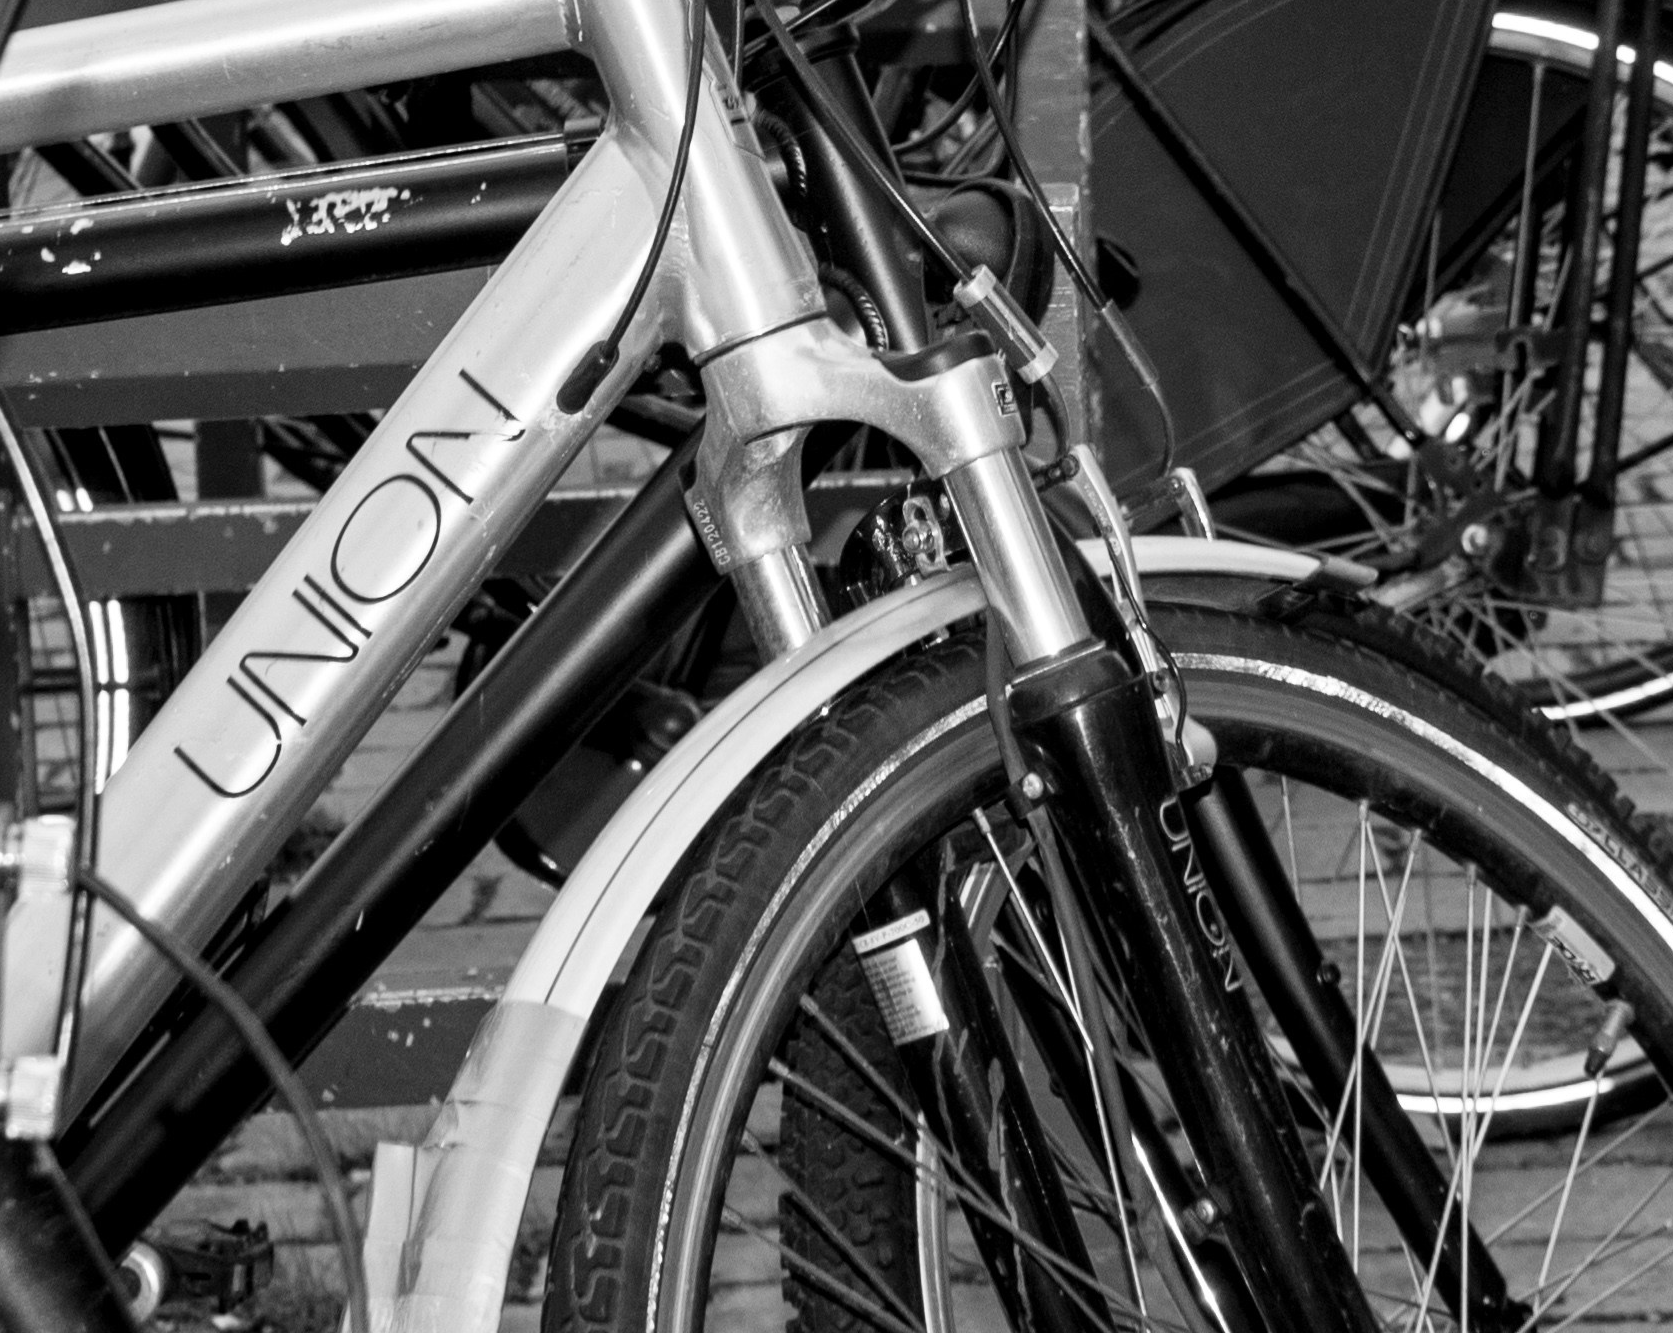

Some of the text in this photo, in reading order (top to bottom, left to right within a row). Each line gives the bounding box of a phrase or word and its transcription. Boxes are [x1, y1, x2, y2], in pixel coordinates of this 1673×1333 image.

[173, 368, 527, 799] UNION
[692, 498, 732, 566] CB120422
[1159, 796, 1243, 992] UNION
